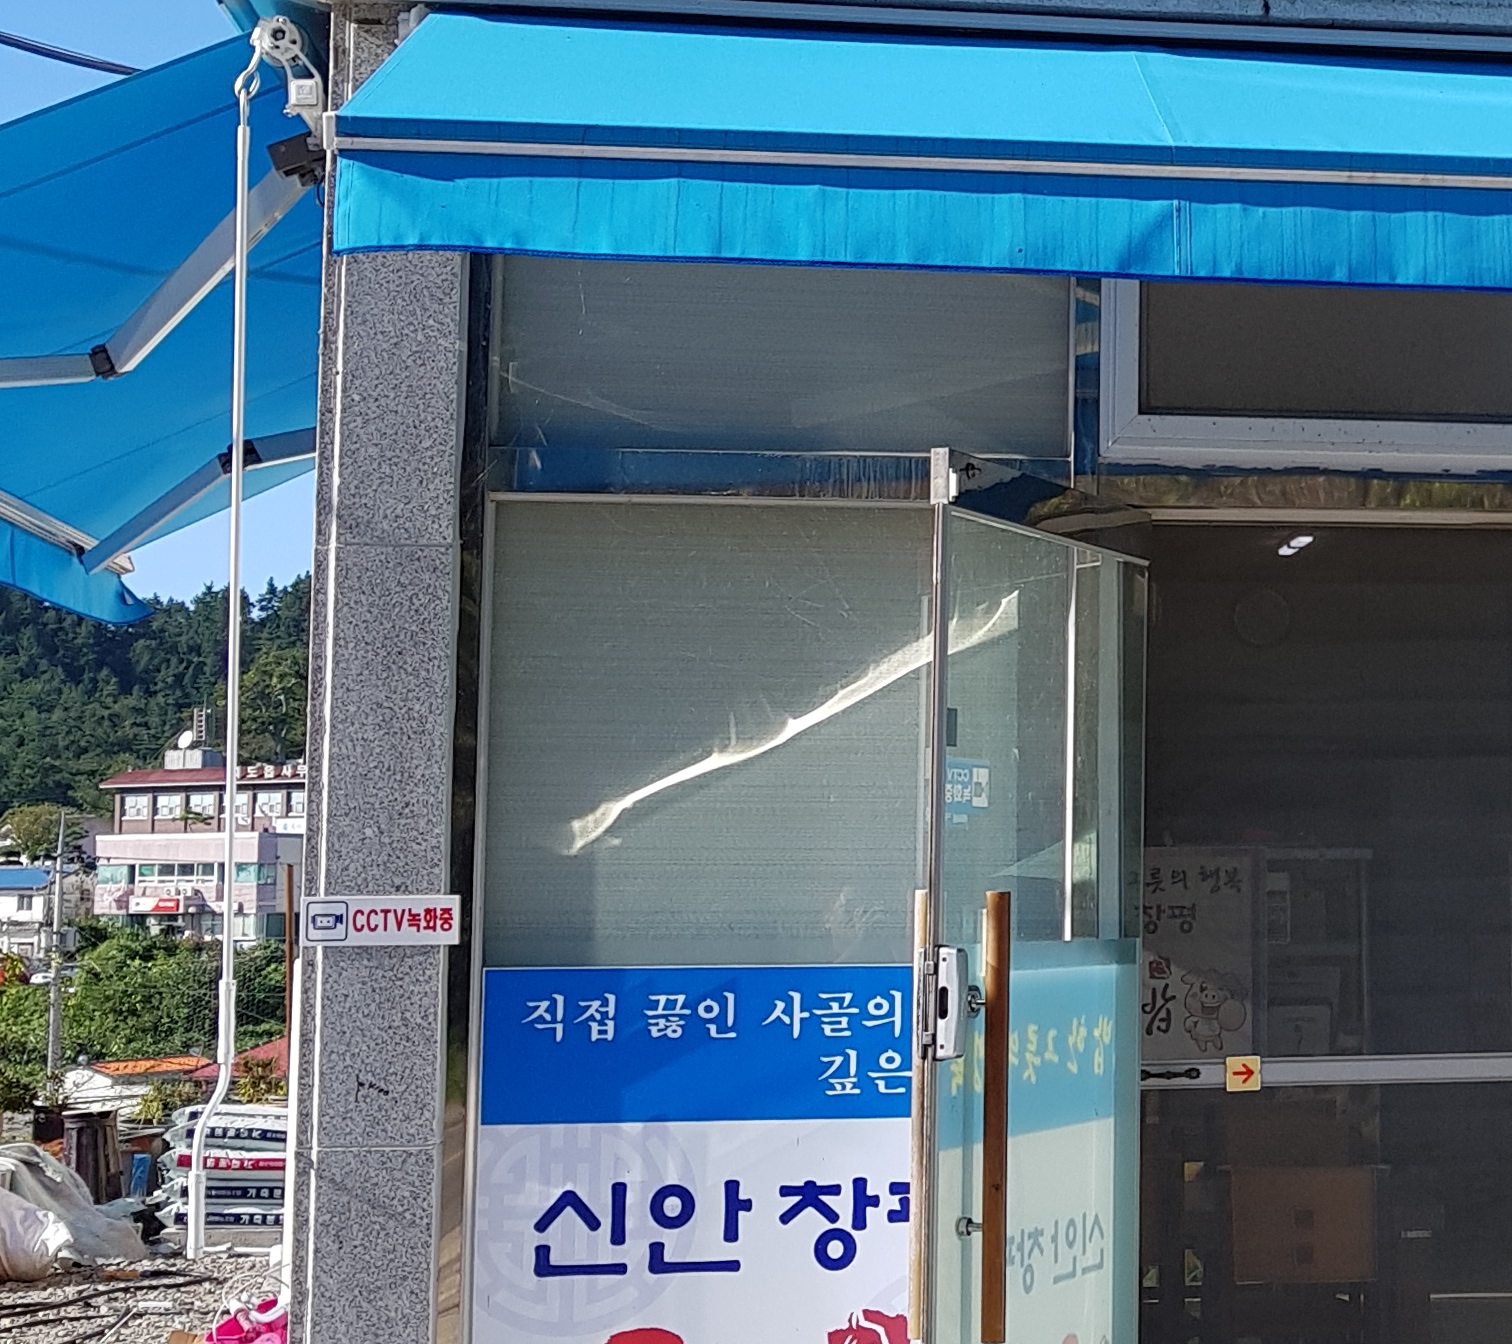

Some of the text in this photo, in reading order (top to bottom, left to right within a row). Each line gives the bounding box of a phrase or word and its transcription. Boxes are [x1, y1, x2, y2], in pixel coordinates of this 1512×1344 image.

[352, 906, 454, 934] CCTV녹화중
[521, 990, 902, 1043] 직접 끓인 사골의
[818, 1048, 911, 1097] 깊은
